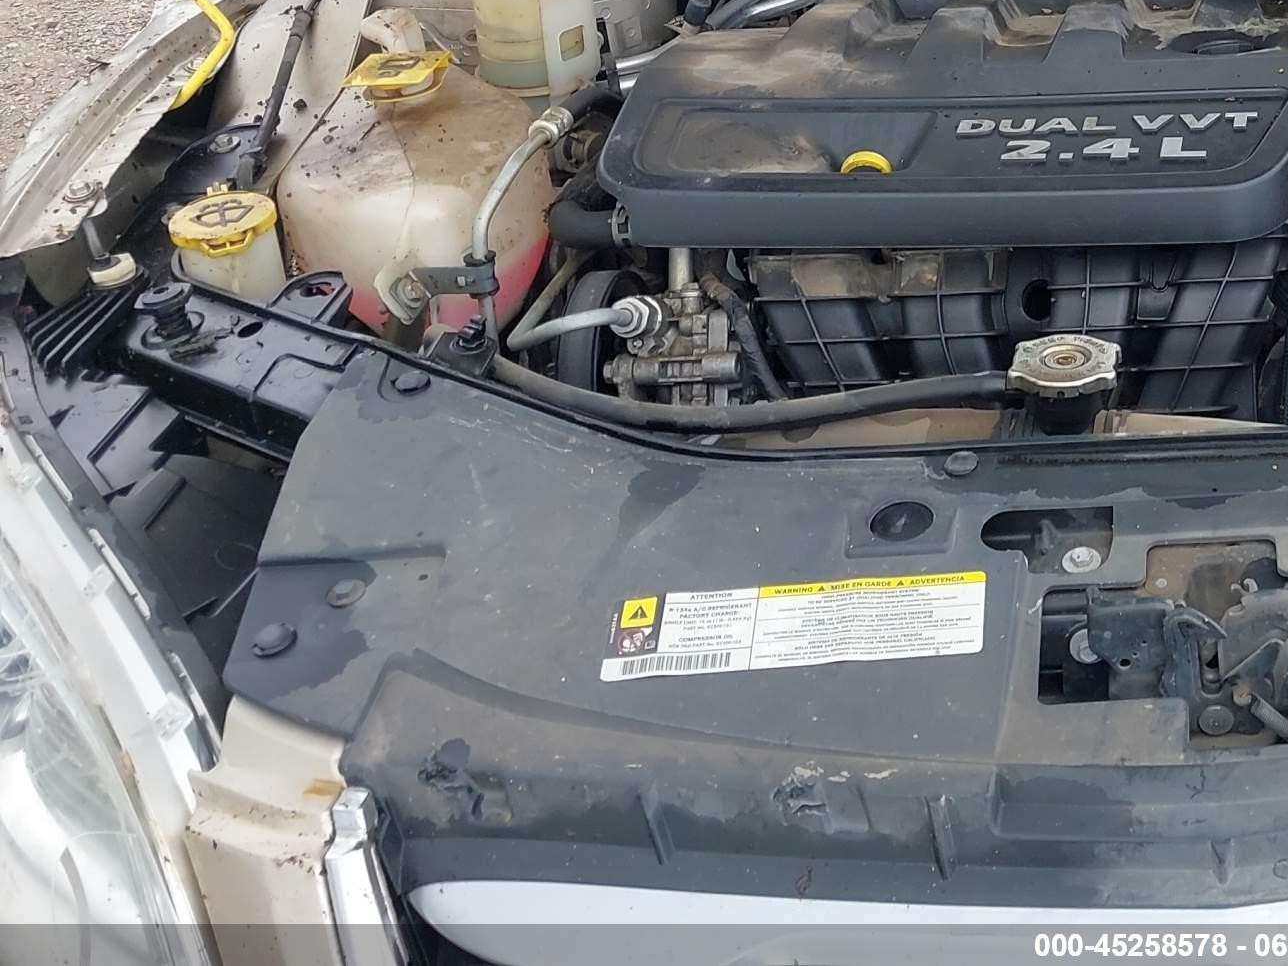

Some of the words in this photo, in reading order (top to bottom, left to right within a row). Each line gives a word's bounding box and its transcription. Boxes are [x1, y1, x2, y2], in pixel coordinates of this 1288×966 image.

[956, 116, 1117, 136] DUAL
[1132, 111, 1258, 131] VVT
[774, 586, 813, 595] WARNING
[830, 582, 850, 591] MISE
[864, 580, 892, 588] GARDE
[910, 575, 965, 585] ADVERTENCIA
[690, 592, 733, 600] ATTENTION
